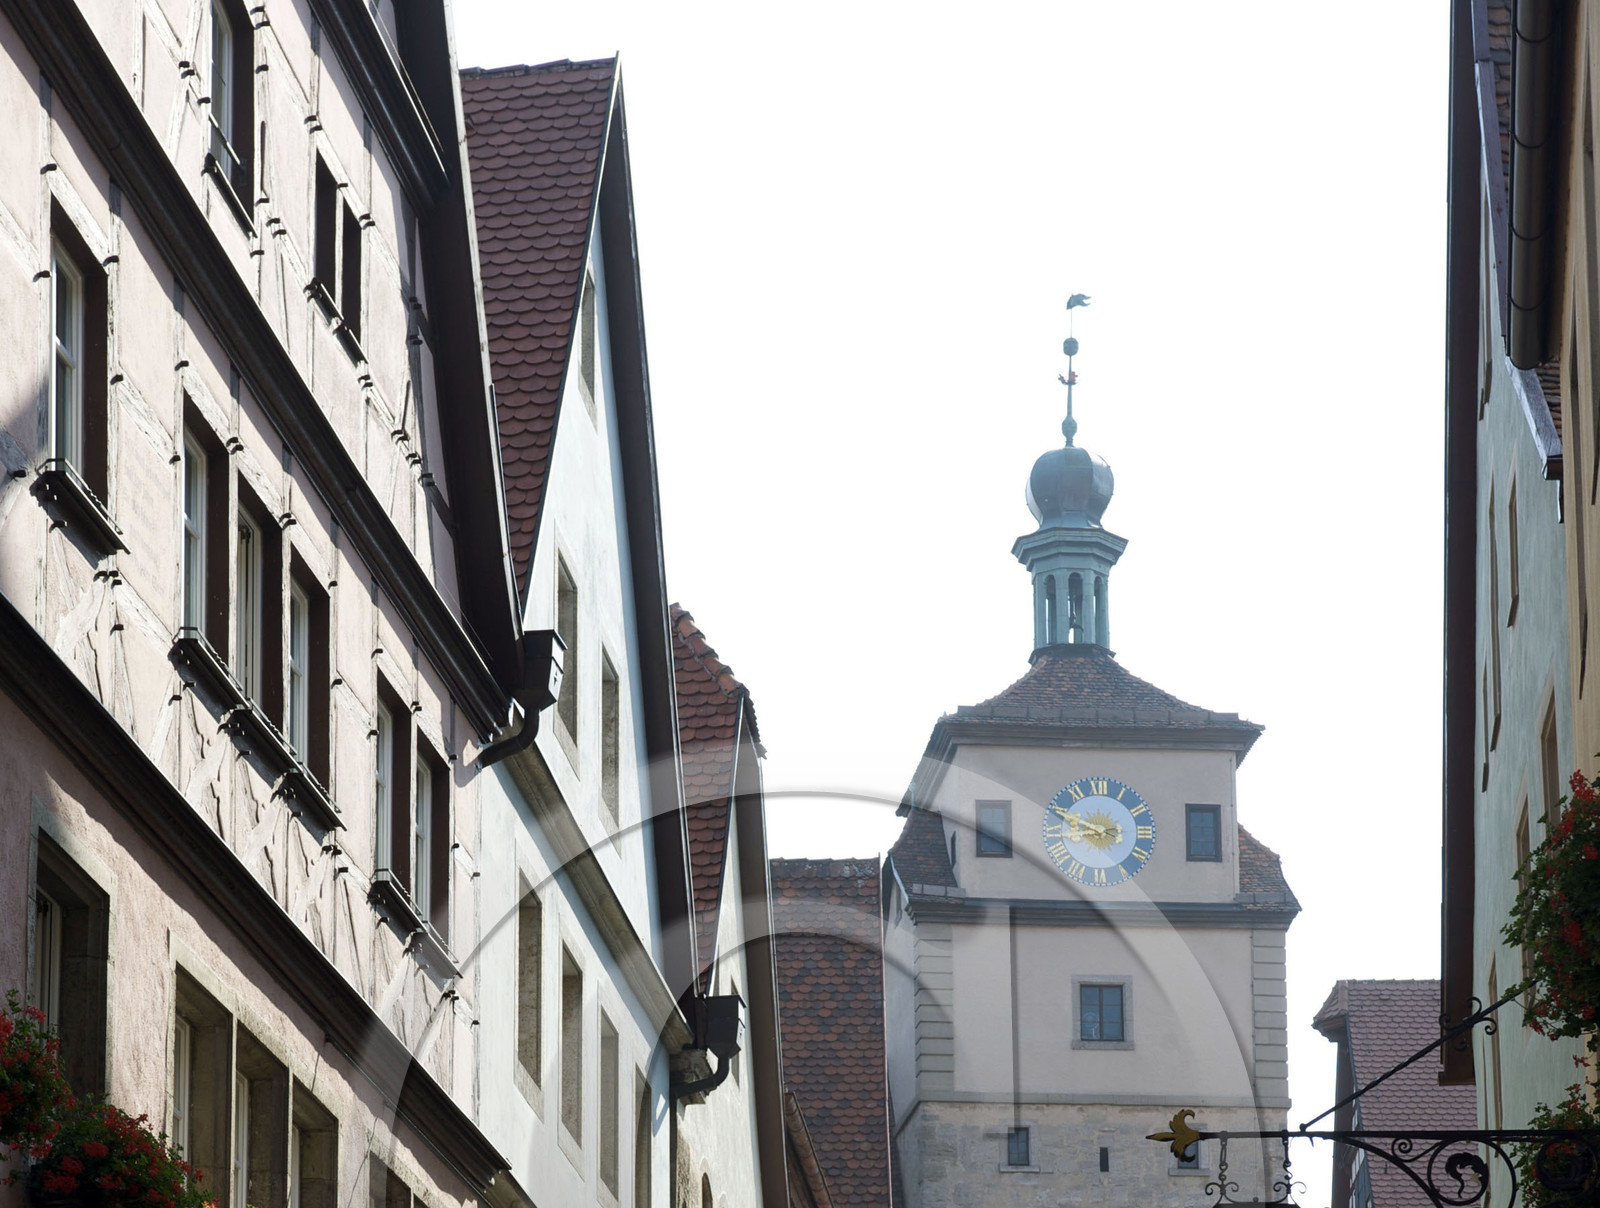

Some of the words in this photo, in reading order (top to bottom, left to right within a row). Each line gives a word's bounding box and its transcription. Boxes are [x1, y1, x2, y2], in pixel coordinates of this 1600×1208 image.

[1067, 785, 1084, 802] XI
[1090, 781, 1107, 795] XII
[1116, 787, 1125, 800] I
[1130, 803, 1146, 817] II
[1137, 826, 1152, 839] III
[1094, 868, 1107, 883] VI
